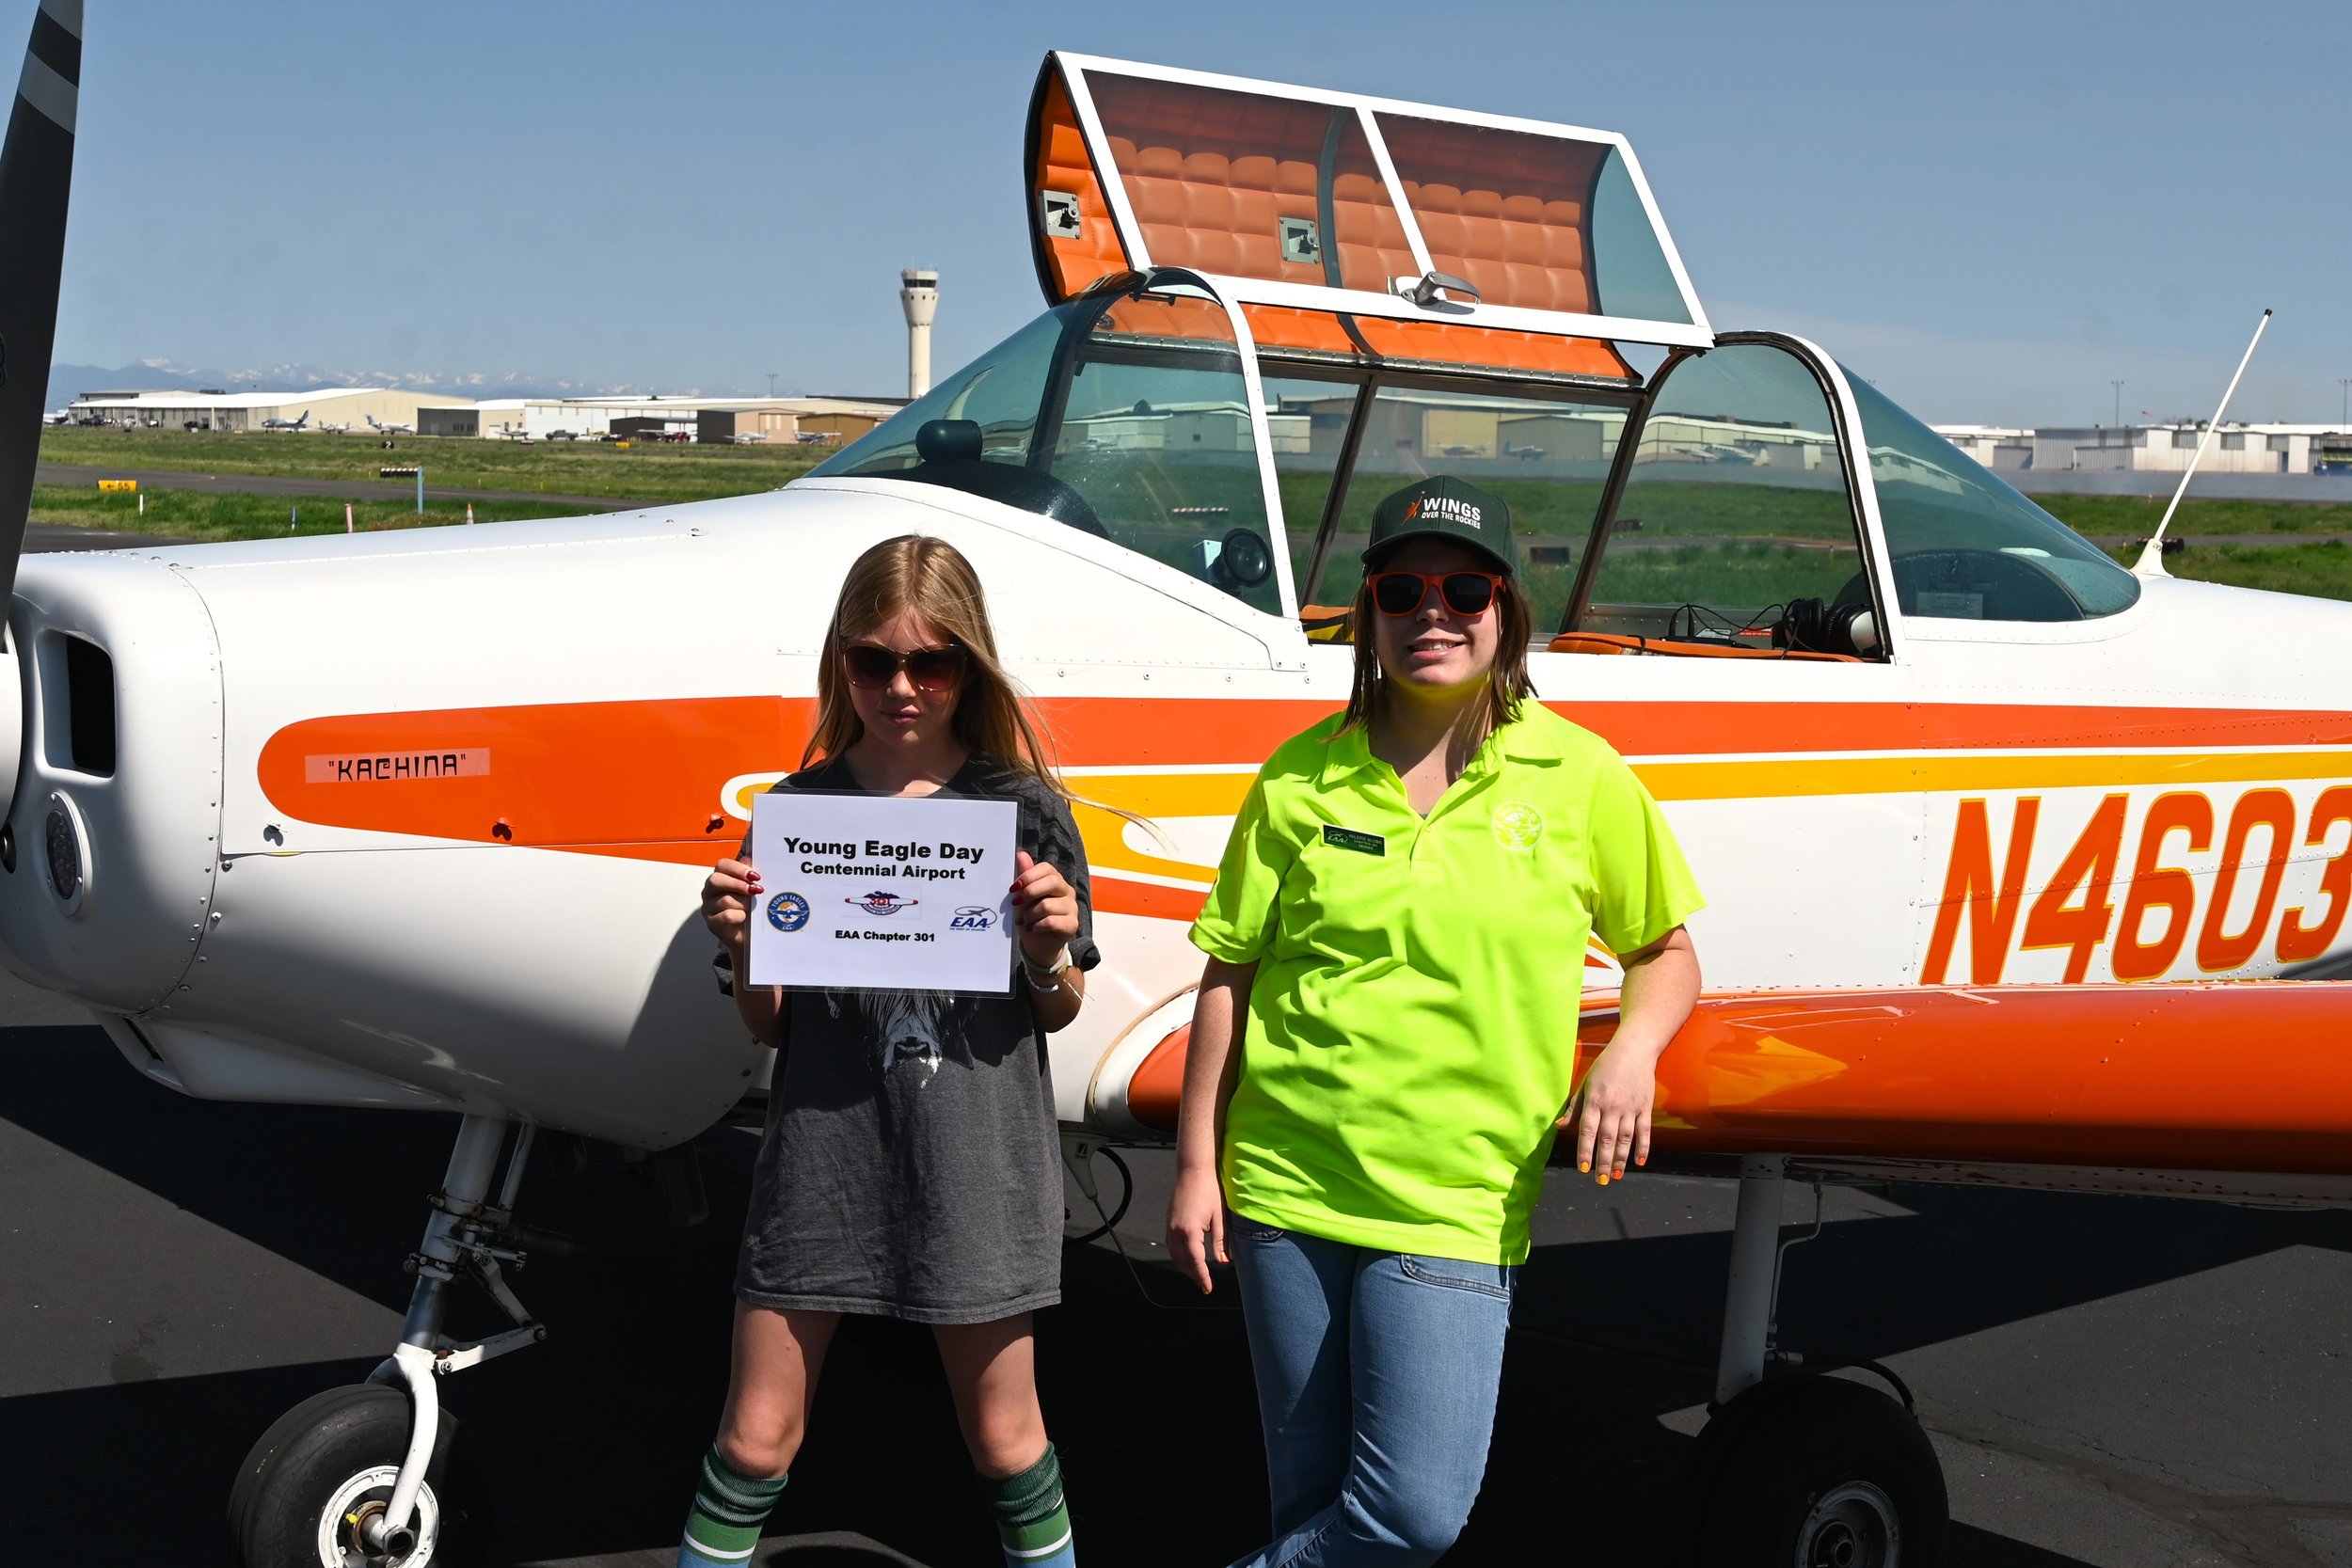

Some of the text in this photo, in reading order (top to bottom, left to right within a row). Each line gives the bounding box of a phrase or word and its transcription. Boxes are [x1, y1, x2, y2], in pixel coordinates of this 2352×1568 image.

[386, 440, 391, 449] 2
[1423, 498, 1481, 520] WINGS
[1441, 512, 1454, 520] THE
[1455, 515, 1481, 530] ROCKIES
[784, 836, 984, 864] Young Eagle Day
[801, 861, 965, 880] Centennial Airport
[771, 895, 806, 909] YOUNG EAGLES
[950, 917, 988, 927] EAA
[834, 929, 935, 942] EAA Chapter 301
